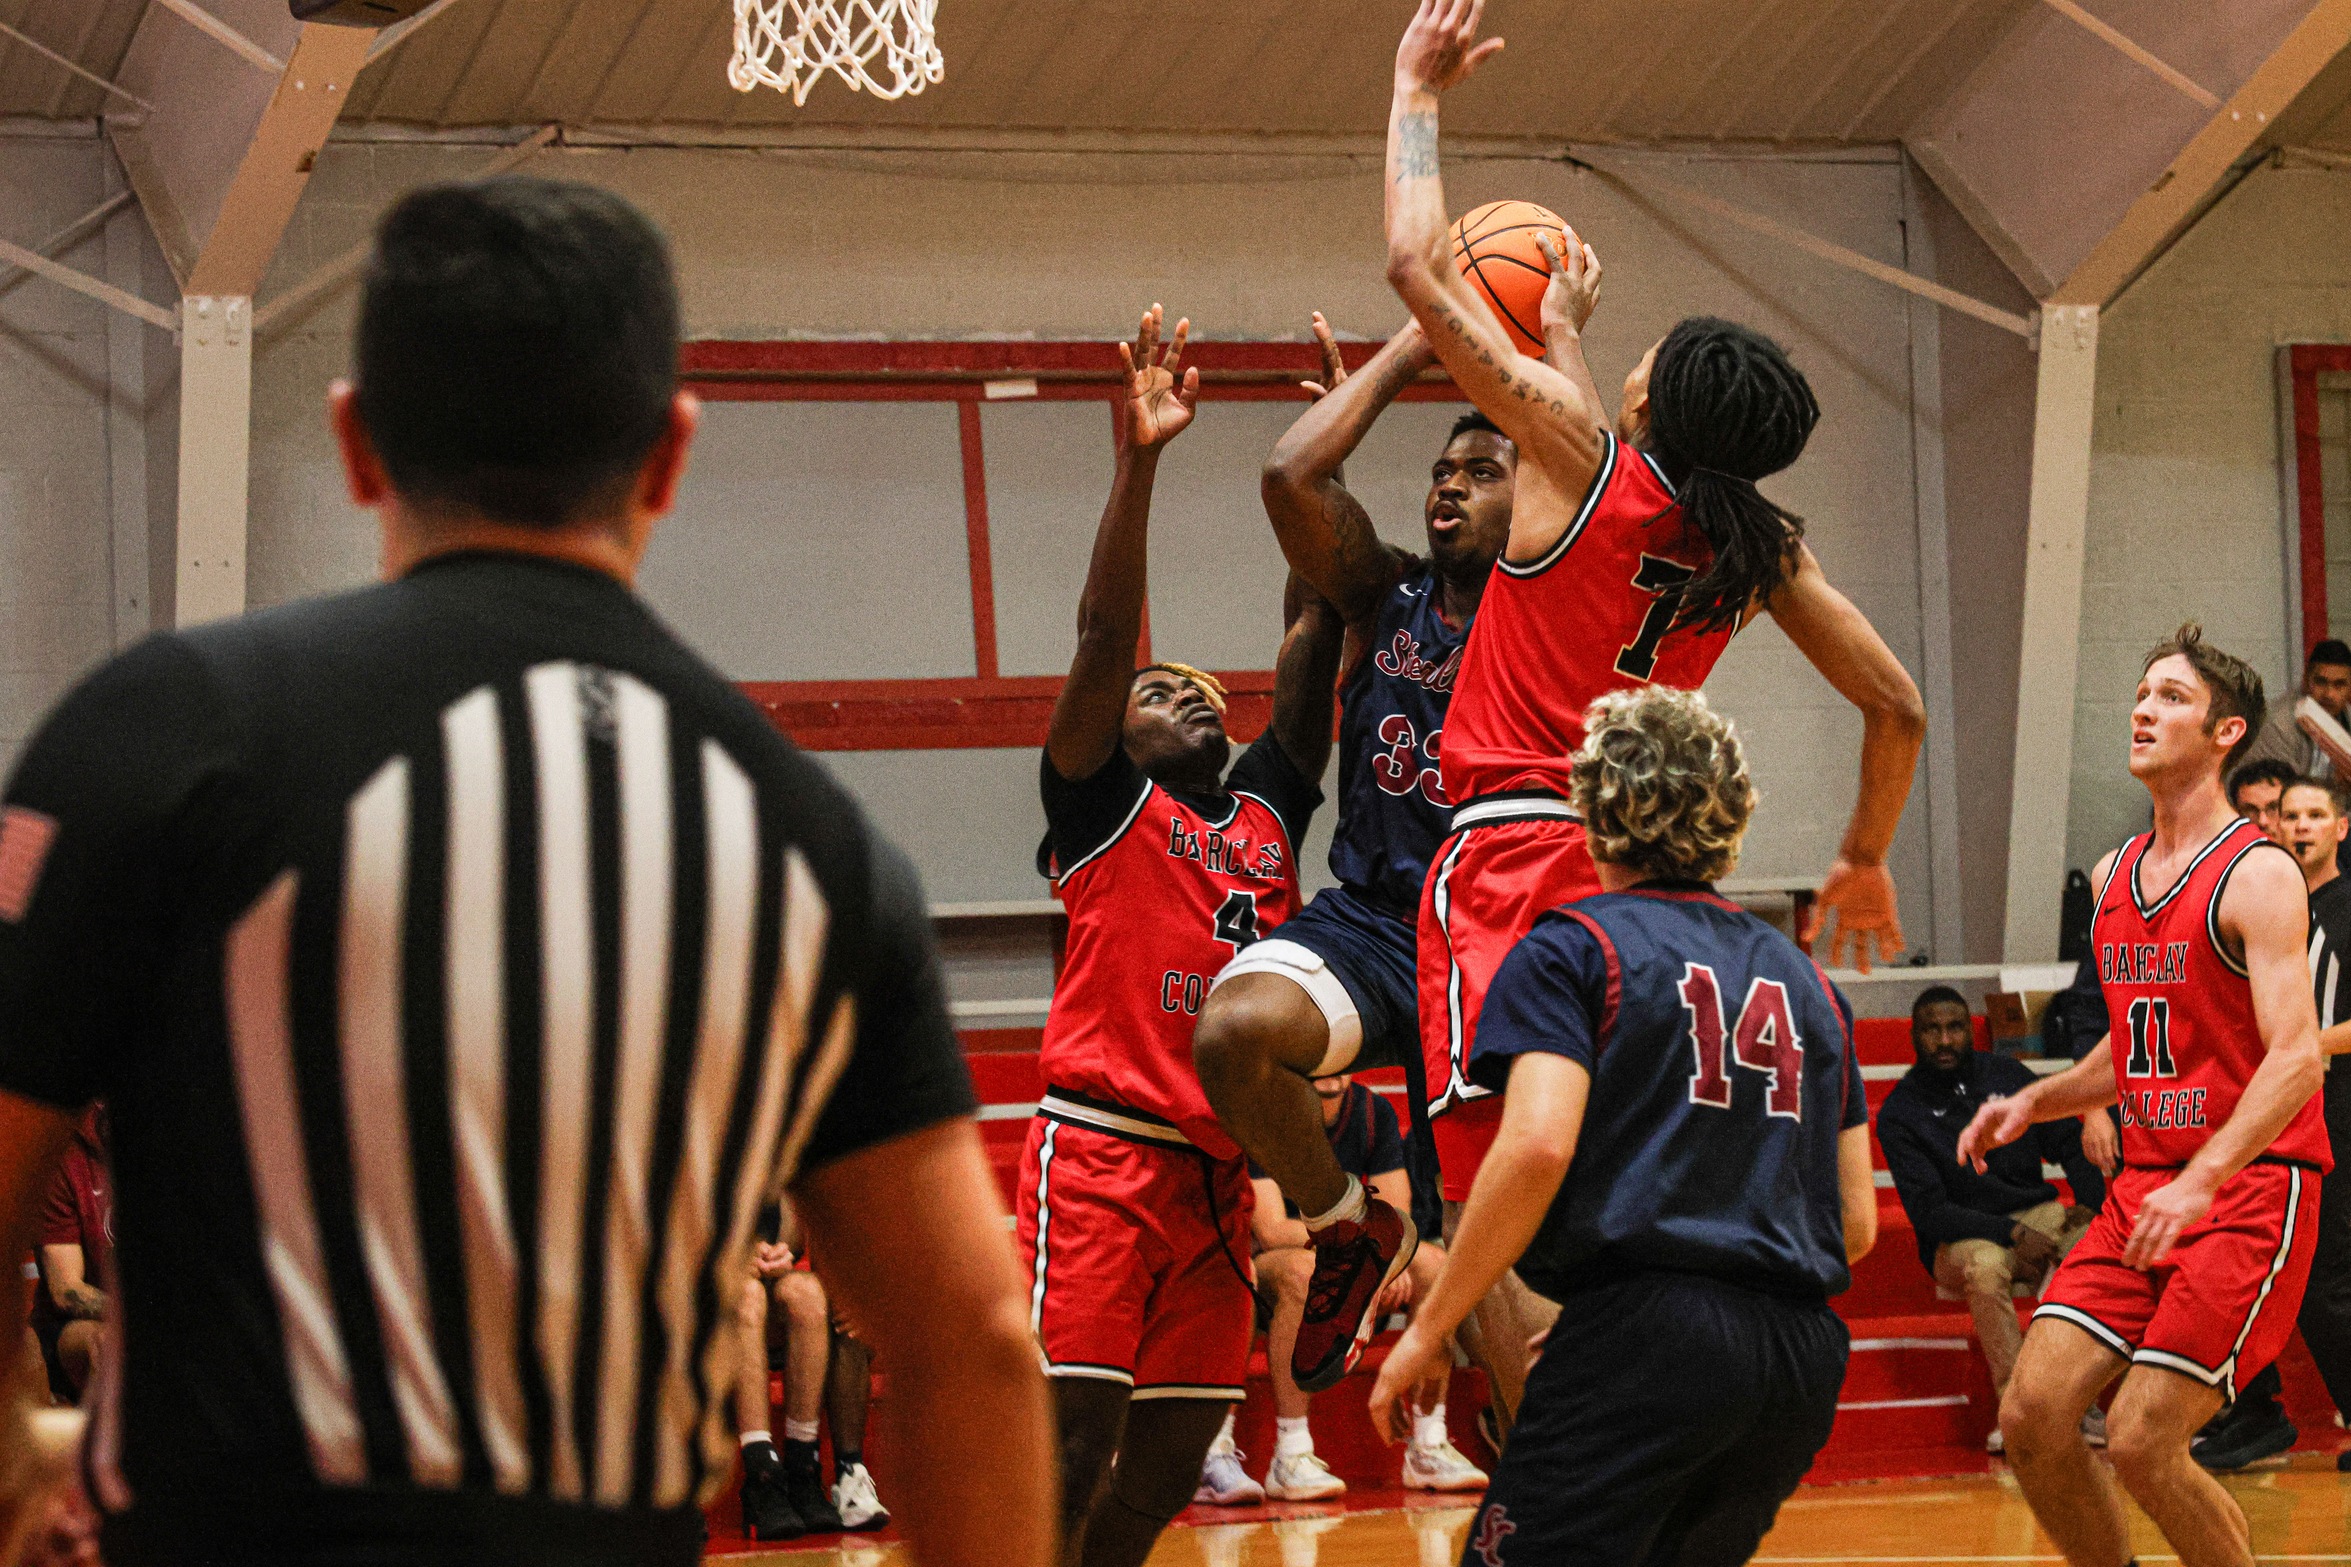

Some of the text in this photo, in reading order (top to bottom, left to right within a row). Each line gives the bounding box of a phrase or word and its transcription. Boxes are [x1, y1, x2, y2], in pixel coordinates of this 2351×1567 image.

[1613, 551, 1697, 683] 7
[1375, 628, 1465, 693] Sterl
[1167, 816, 1285, 880] BARCLAY
[1212, 888, 1261, 957] 4
[1160, 969, 1216, 1016] CO
[2102, 941, 2189, 985] BARCLAY
[1676, 961, 1804, 1125] 14
[2126, 996, 2178, 1079] 11
[2120, 1087, 2207, 1131] CLEGE
